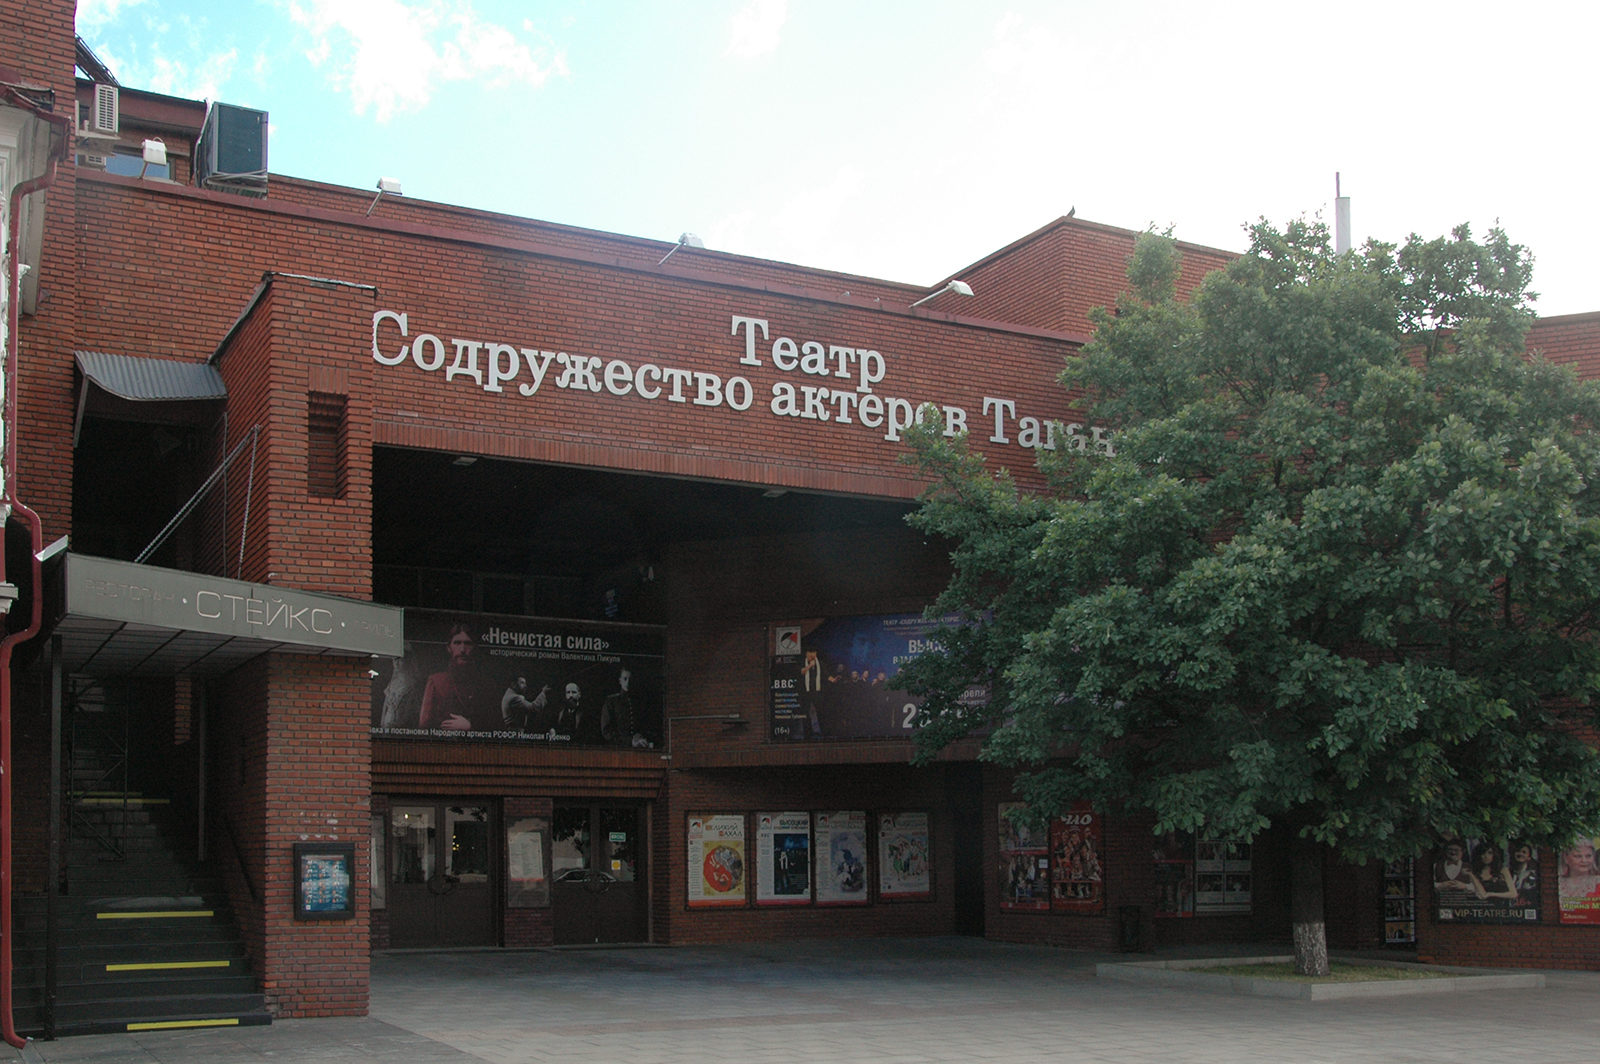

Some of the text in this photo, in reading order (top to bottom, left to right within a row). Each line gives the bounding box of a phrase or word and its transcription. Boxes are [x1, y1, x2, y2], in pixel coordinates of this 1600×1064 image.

[731, 315, 886, 393] Театр
[372, 310, 754, 410] Содружество
[982, 396, 1117, 458] Таган
[196, 590, 332, 634] СТЕЙКС
[481, 627, 609, 651] «Нечистая сила»
[390, 727, 429, 735] постановка
[430, 729, 466, 737] Народного
[466, 731, 492, 739] артиста
[492, 730, 517, 739] РСФСР
[1454, 908, 1523, 919] VIP-TEATRE.RU
